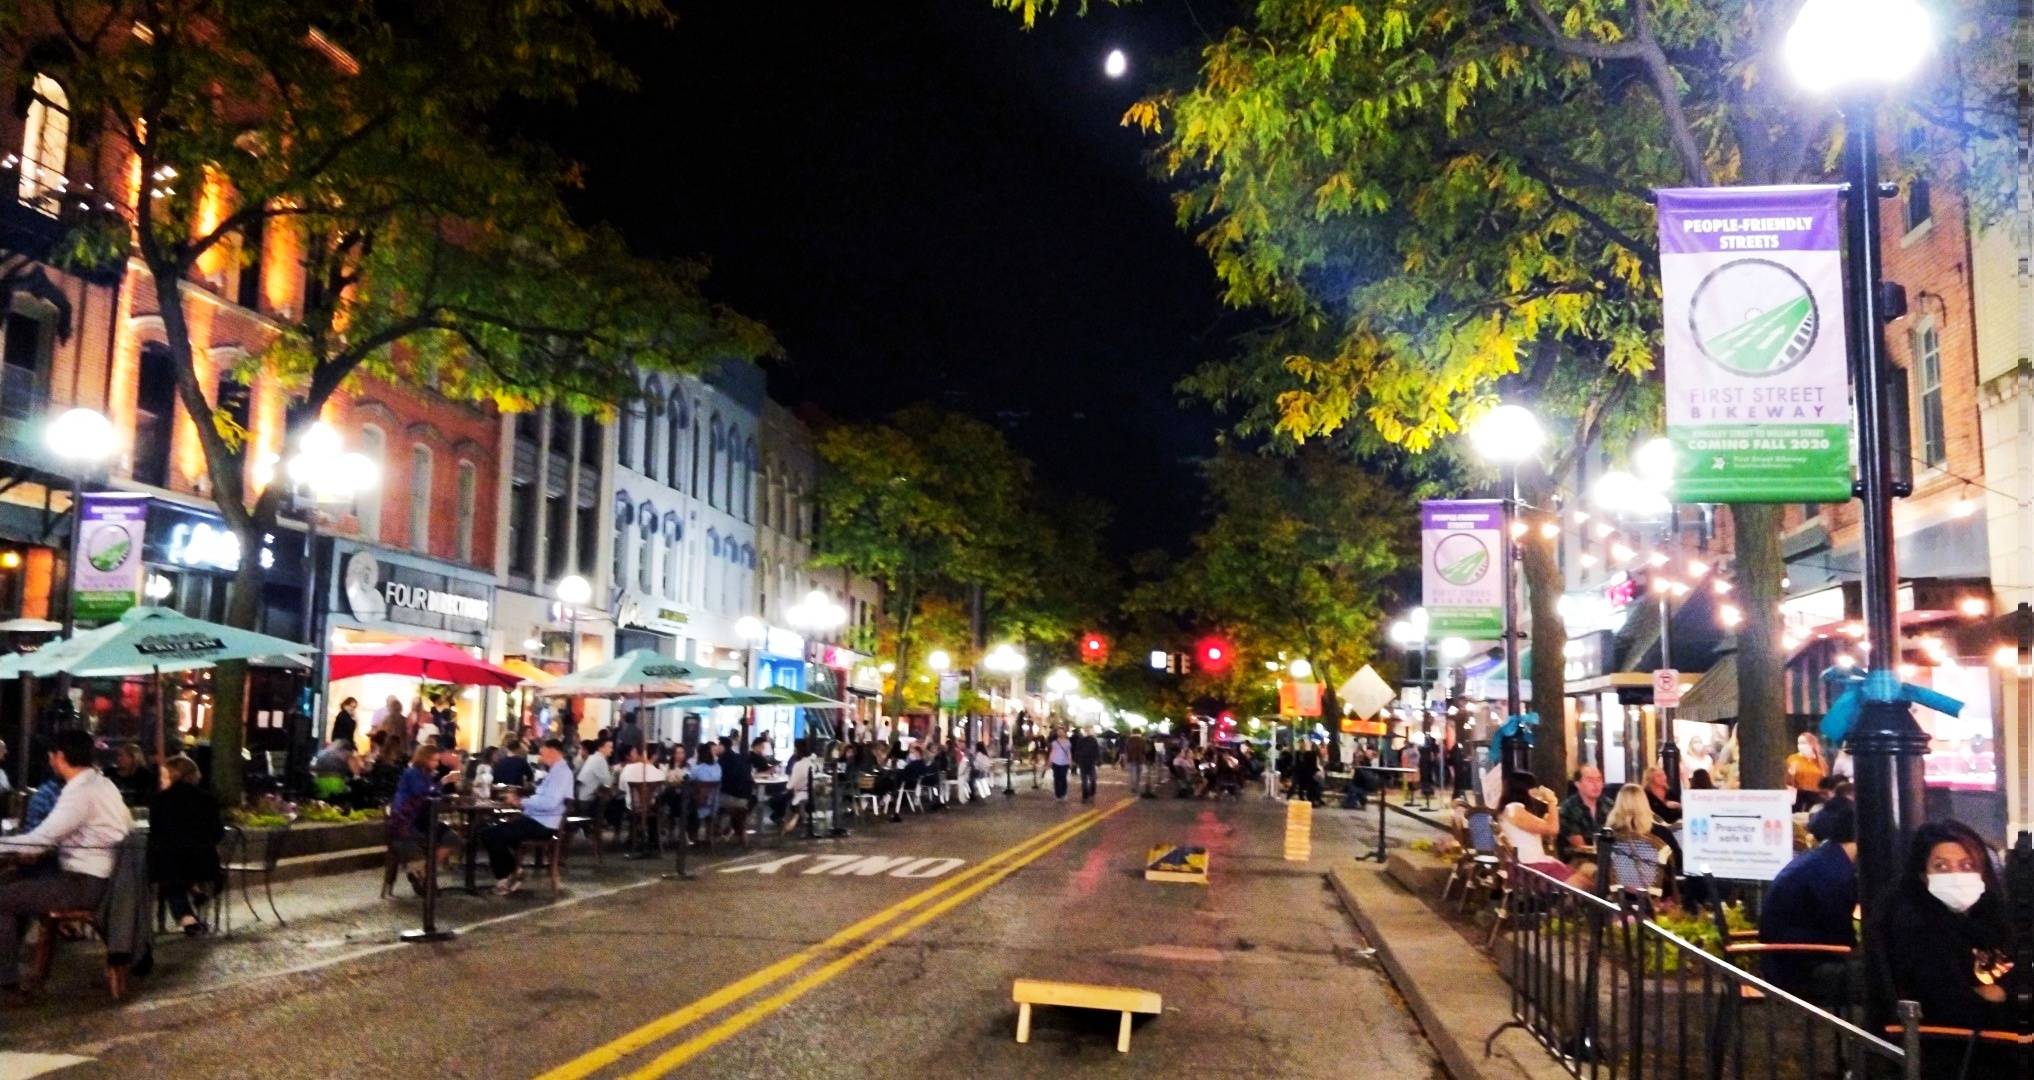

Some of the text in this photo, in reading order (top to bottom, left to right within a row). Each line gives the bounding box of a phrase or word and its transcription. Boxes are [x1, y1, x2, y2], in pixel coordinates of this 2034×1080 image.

[1683, 217, 1813, 233] PEOPLE-FRIENDLY
[1719, 234, 1780, 250] STREETS
[1690, 387, 1825, 404] FIRST STREET
[1690, 405, 1825, 419] BIKEWAY
[1729, 429, 1754, 438] STREET
[1756, 429, 1765, 438] TO
[1766, 429, 1798, 438] WILLIAM
[1799, 428, 1825, 438] STREET
[1687, 438, 1830, 450] COMING FALL 2020
[385, 581, 428, 611] FOUR
[1715, 823, 1756, 833] Practice
[717, 853, 966, 878] ONLY
